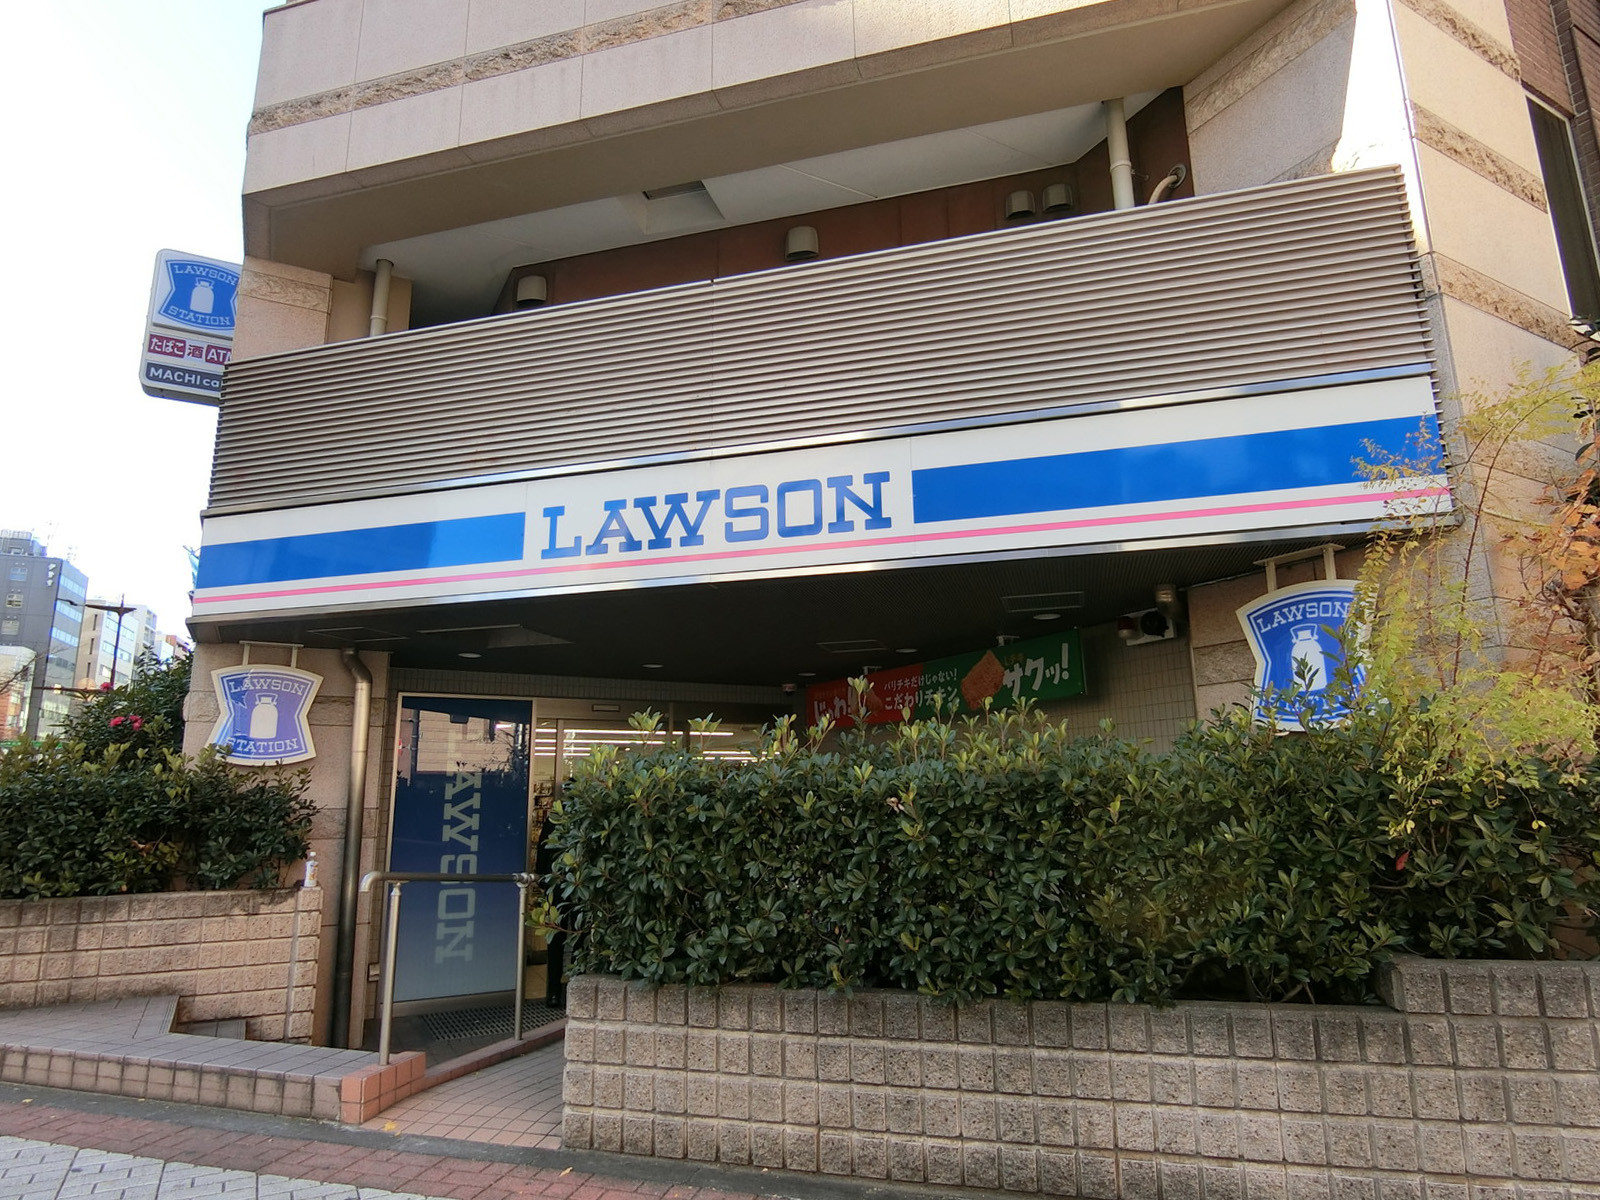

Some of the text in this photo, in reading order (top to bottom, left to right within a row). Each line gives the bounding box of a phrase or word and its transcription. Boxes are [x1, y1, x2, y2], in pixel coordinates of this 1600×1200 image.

[173, 264, 238, 286] LAWSON
[168, 305, 231, 326] STATION
[150, 337, 184, 355] たばこ
[187, 344, 204, 359] 酒
[149, 366, 221, 388] MACHI ca
[541, 471, 892, 560] LAWSON
[1257, 601, 1349, 634] LAWSON
[1002, 642, 1070, 698] サクッ!
[229, 678, 306, 696] LAWSON
[225, 736, 299, 753] STATION
[435, 728, 482, 964] LAWSON
